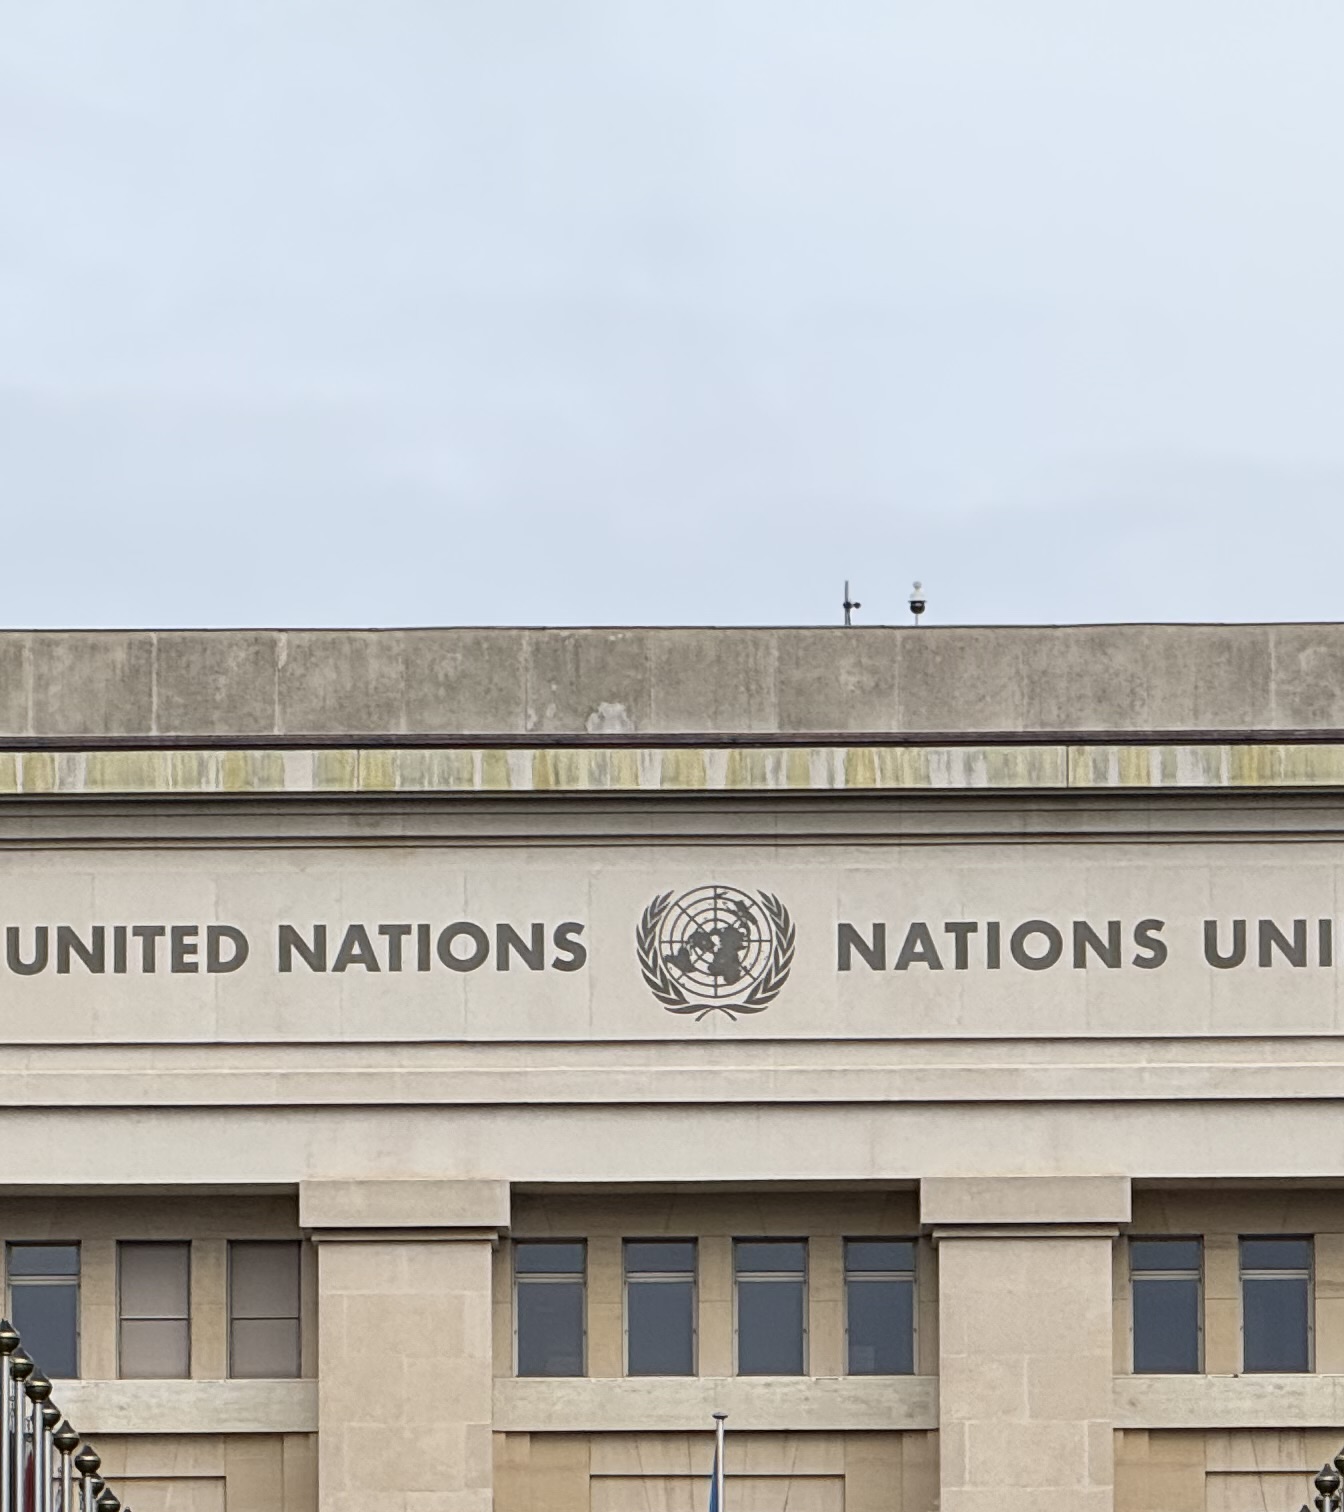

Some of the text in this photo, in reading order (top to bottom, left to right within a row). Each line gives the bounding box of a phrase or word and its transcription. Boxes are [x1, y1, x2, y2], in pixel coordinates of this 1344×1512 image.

[6, 921, 587, 976] UNITED NATIONS
[837, 918, 1168, 972] NATIONS
